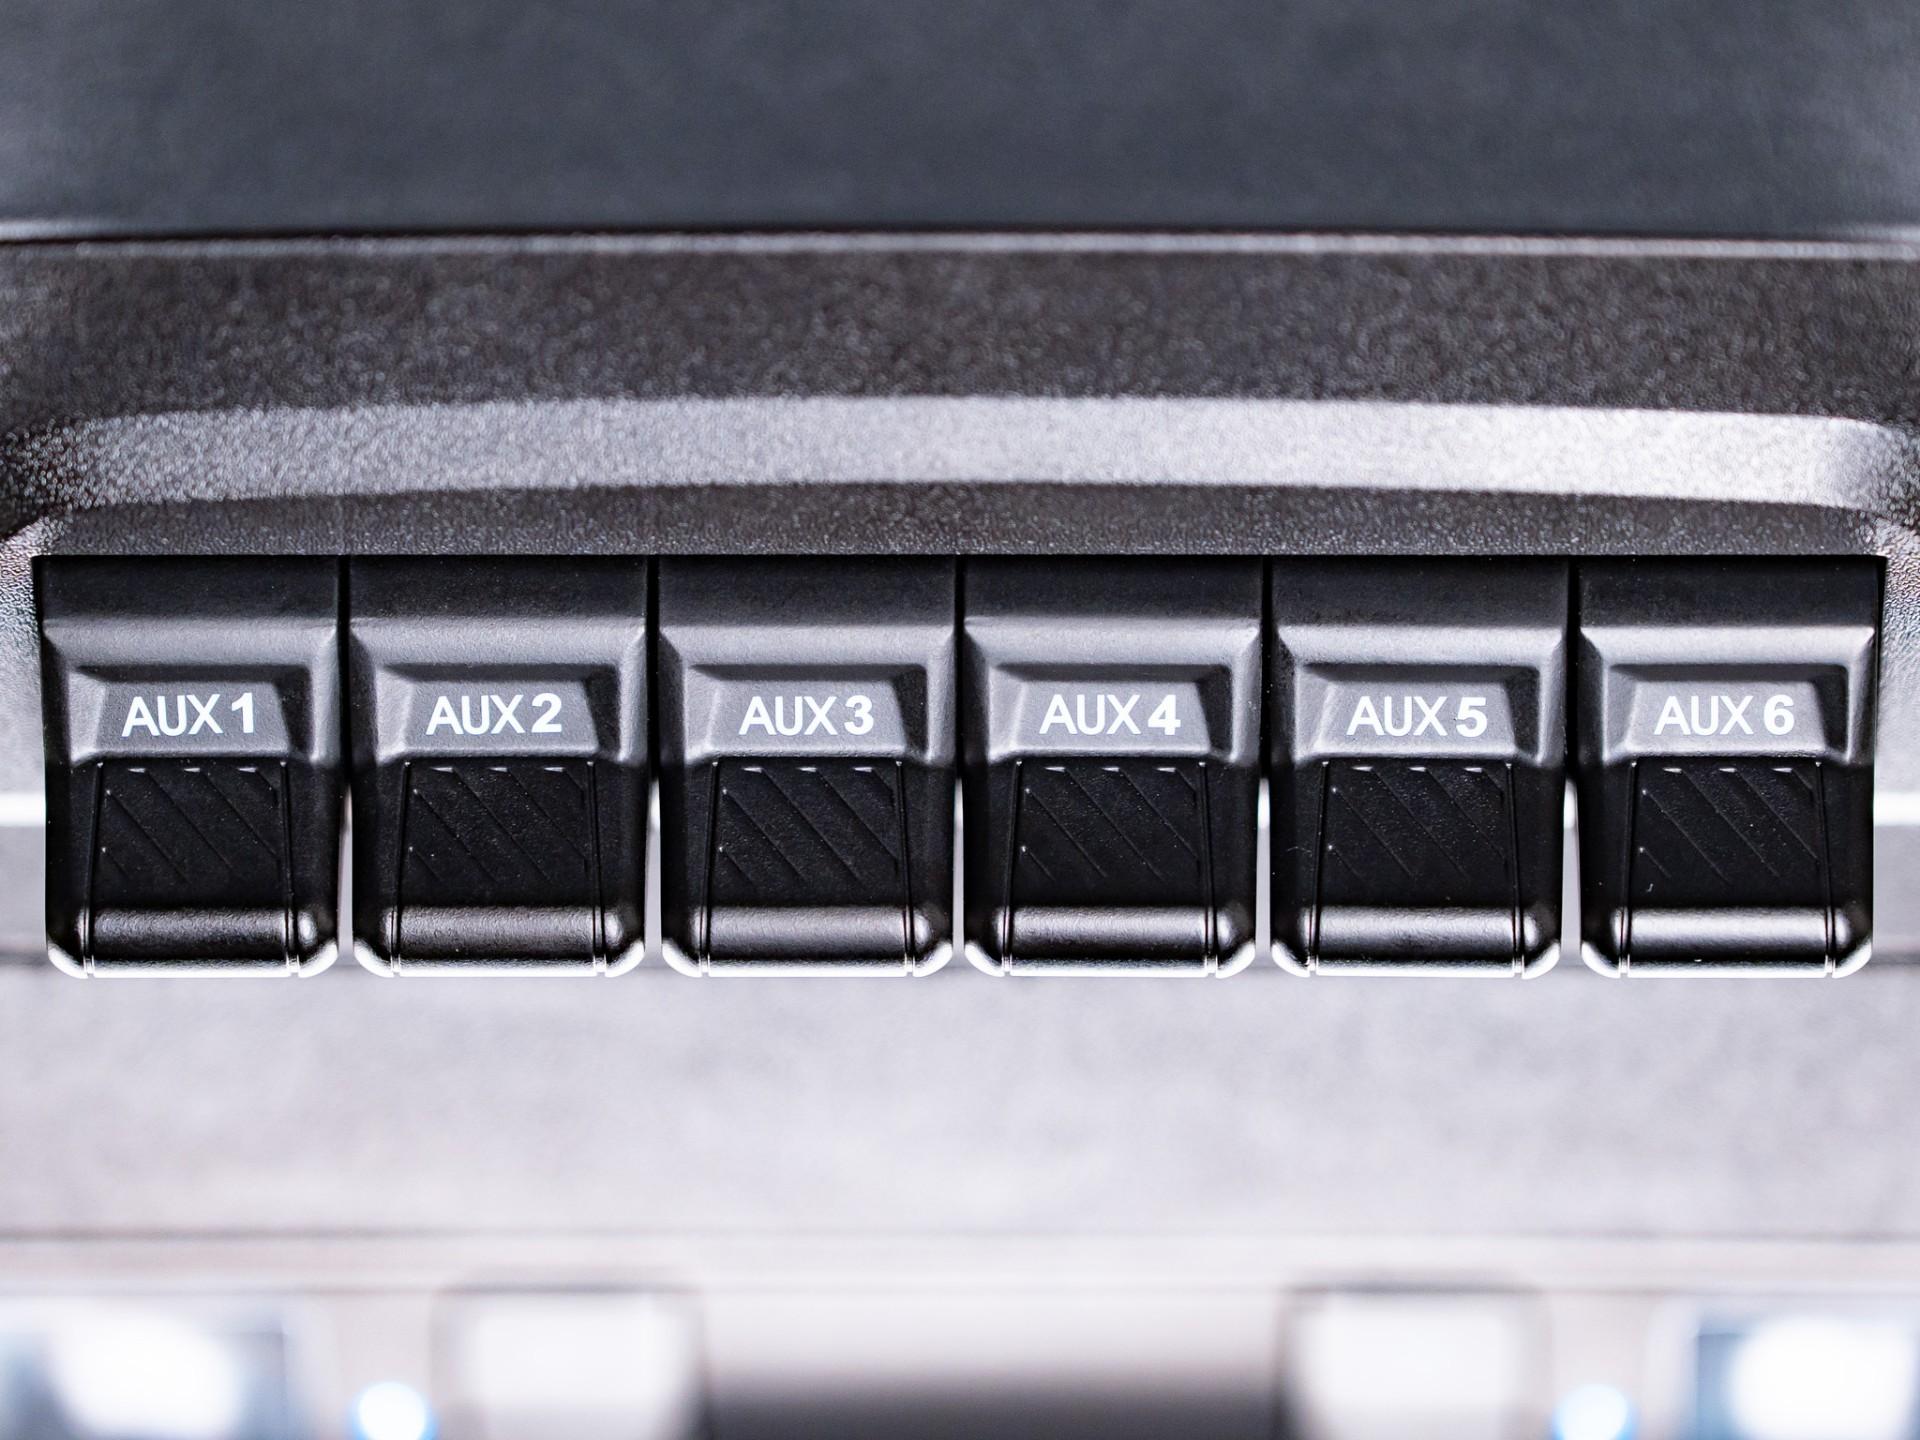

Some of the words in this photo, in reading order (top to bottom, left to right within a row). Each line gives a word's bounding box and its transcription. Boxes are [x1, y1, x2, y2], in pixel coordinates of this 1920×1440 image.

[122, 694, 223, 736] AUX
[231, 692, 254, 733] 1
[426, 694, 525, 735] AUX
[531, 693, 562, 733] 2
[739, 695, 839, 736] AUX
[844, 694, 875, 736] 3
[1039, 694, 1141, 735] AUX
[1147, 694, 1181, 735] 4
[1347, 695, 1448, 737] AUX
[1456, 696, 1488, 737] 5
[1653, 695, 1754, 736] AUX
[1762, 694, 1795, 735] 6
